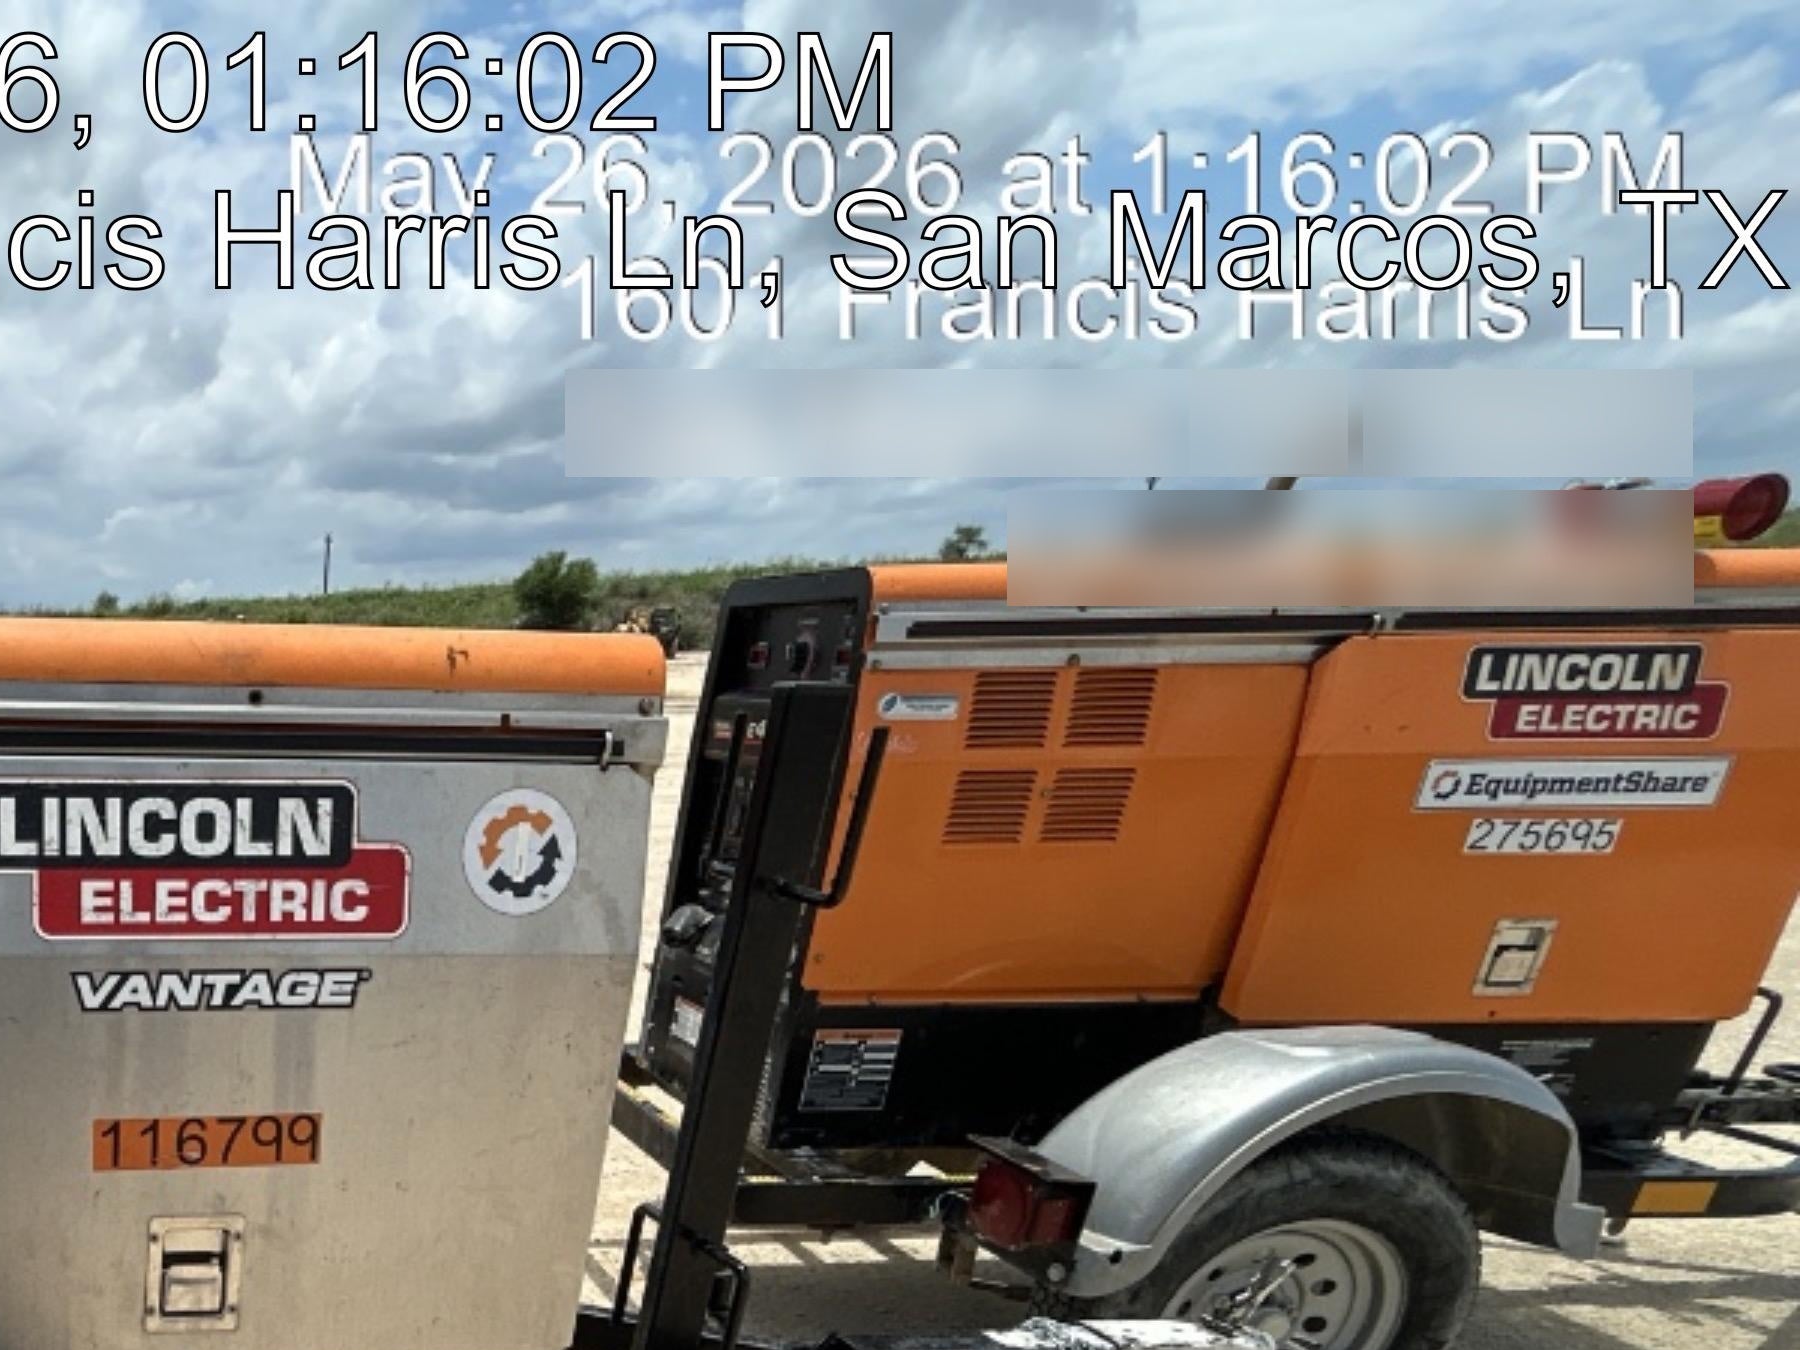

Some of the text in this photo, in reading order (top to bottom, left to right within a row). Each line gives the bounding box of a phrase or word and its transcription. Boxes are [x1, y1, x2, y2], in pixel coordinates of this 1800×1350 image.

[1475, 652, 1690, 692] LINCOLN
[1514, 702, 1701, 734] ELECTRIC
[1463, 769, 1710, 801] EquipmentShare
[1466, 818, 1620, 851] 275695
[79, 877, 370, 925] ELECTRIC
[71, 970, 360, 1011] VANTAGE
[100, 1114, 319, 1169] 116799
